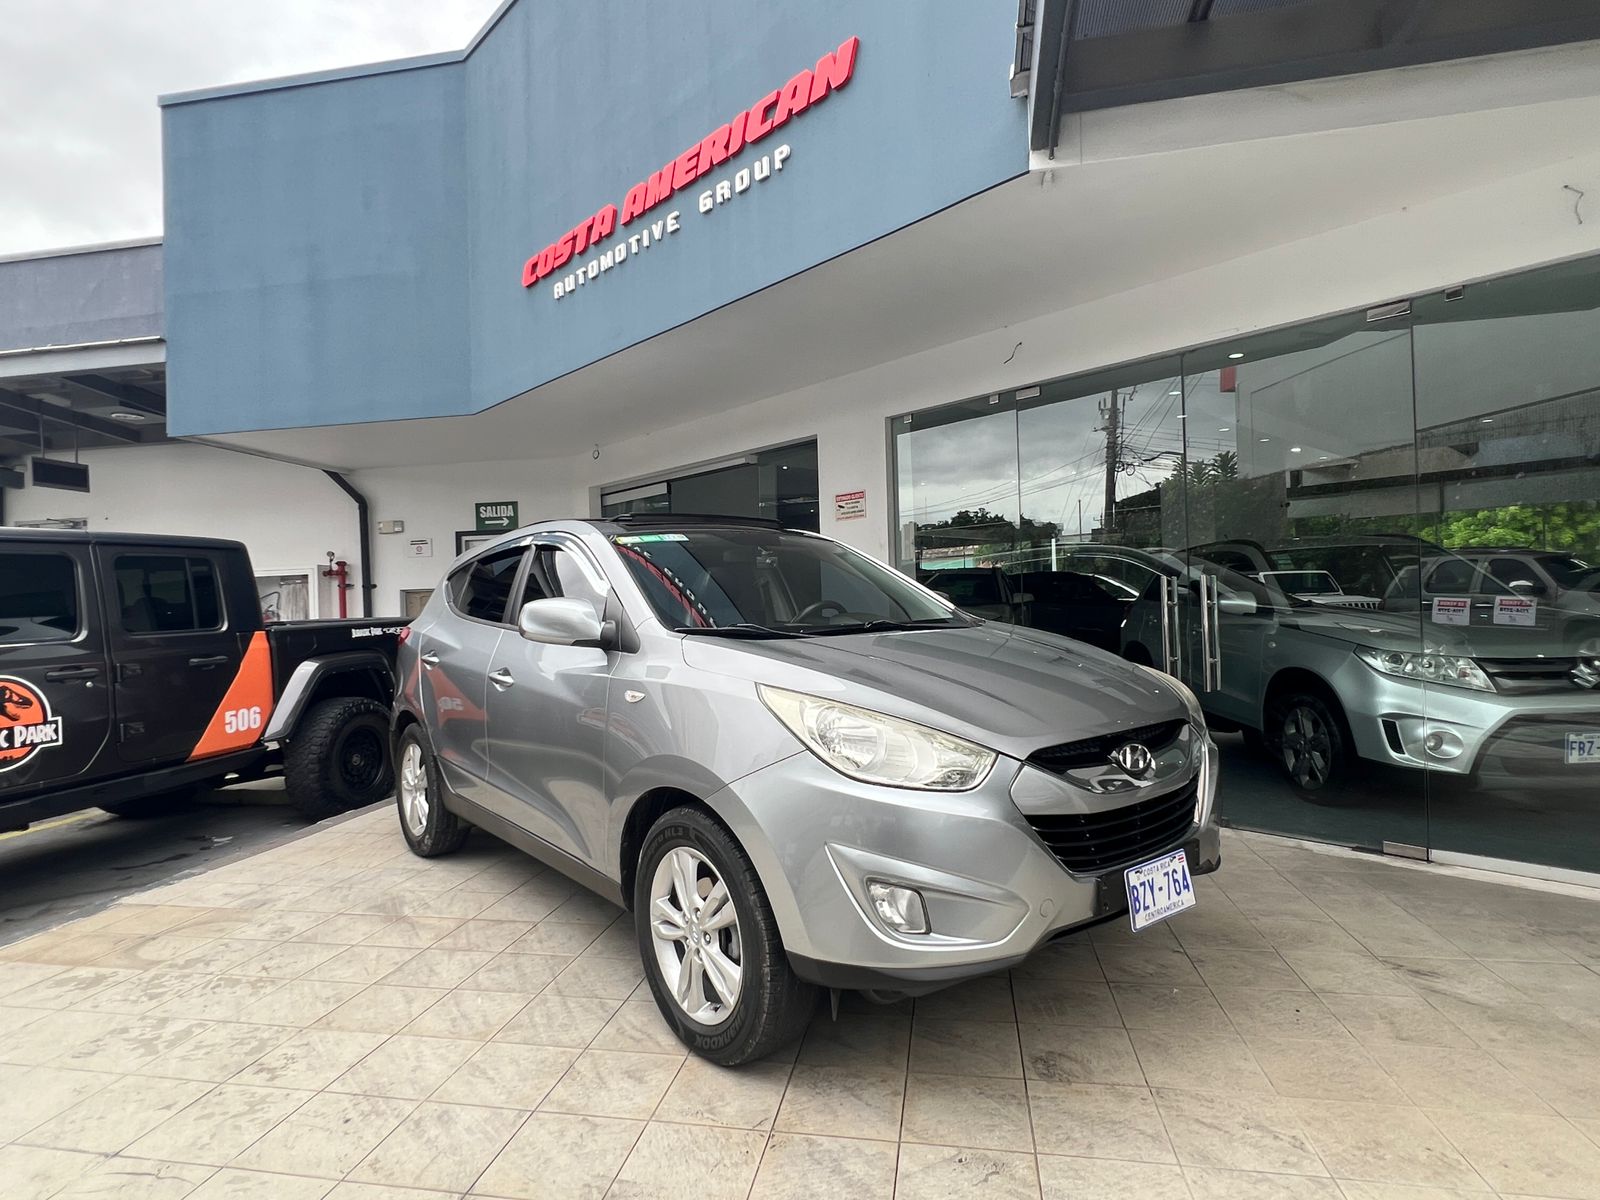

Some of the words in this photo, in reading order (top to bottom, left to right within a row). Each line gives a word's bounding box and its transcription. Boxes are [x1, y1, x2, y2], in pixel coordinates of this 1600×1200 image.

[522, 203, 618, 288] COSTA
[620, 35, 860, 226] AMERICAN
[553, 210, 681, 300] AUTOMOTIVE
[698, 143, 792, 214] GROUP
[479, 504, 515, 519] SALIDA
[224, 705, 261, 734] 506
[13, 723, 58, 748] PARK
[1143, 864, 1160, 877] COSTA
[1160, 860, 1171, 873] RICA
[1130, 864, 1191, 915] BZY-764
[1144, 899, 1185, 922] CENTROAMERICA
